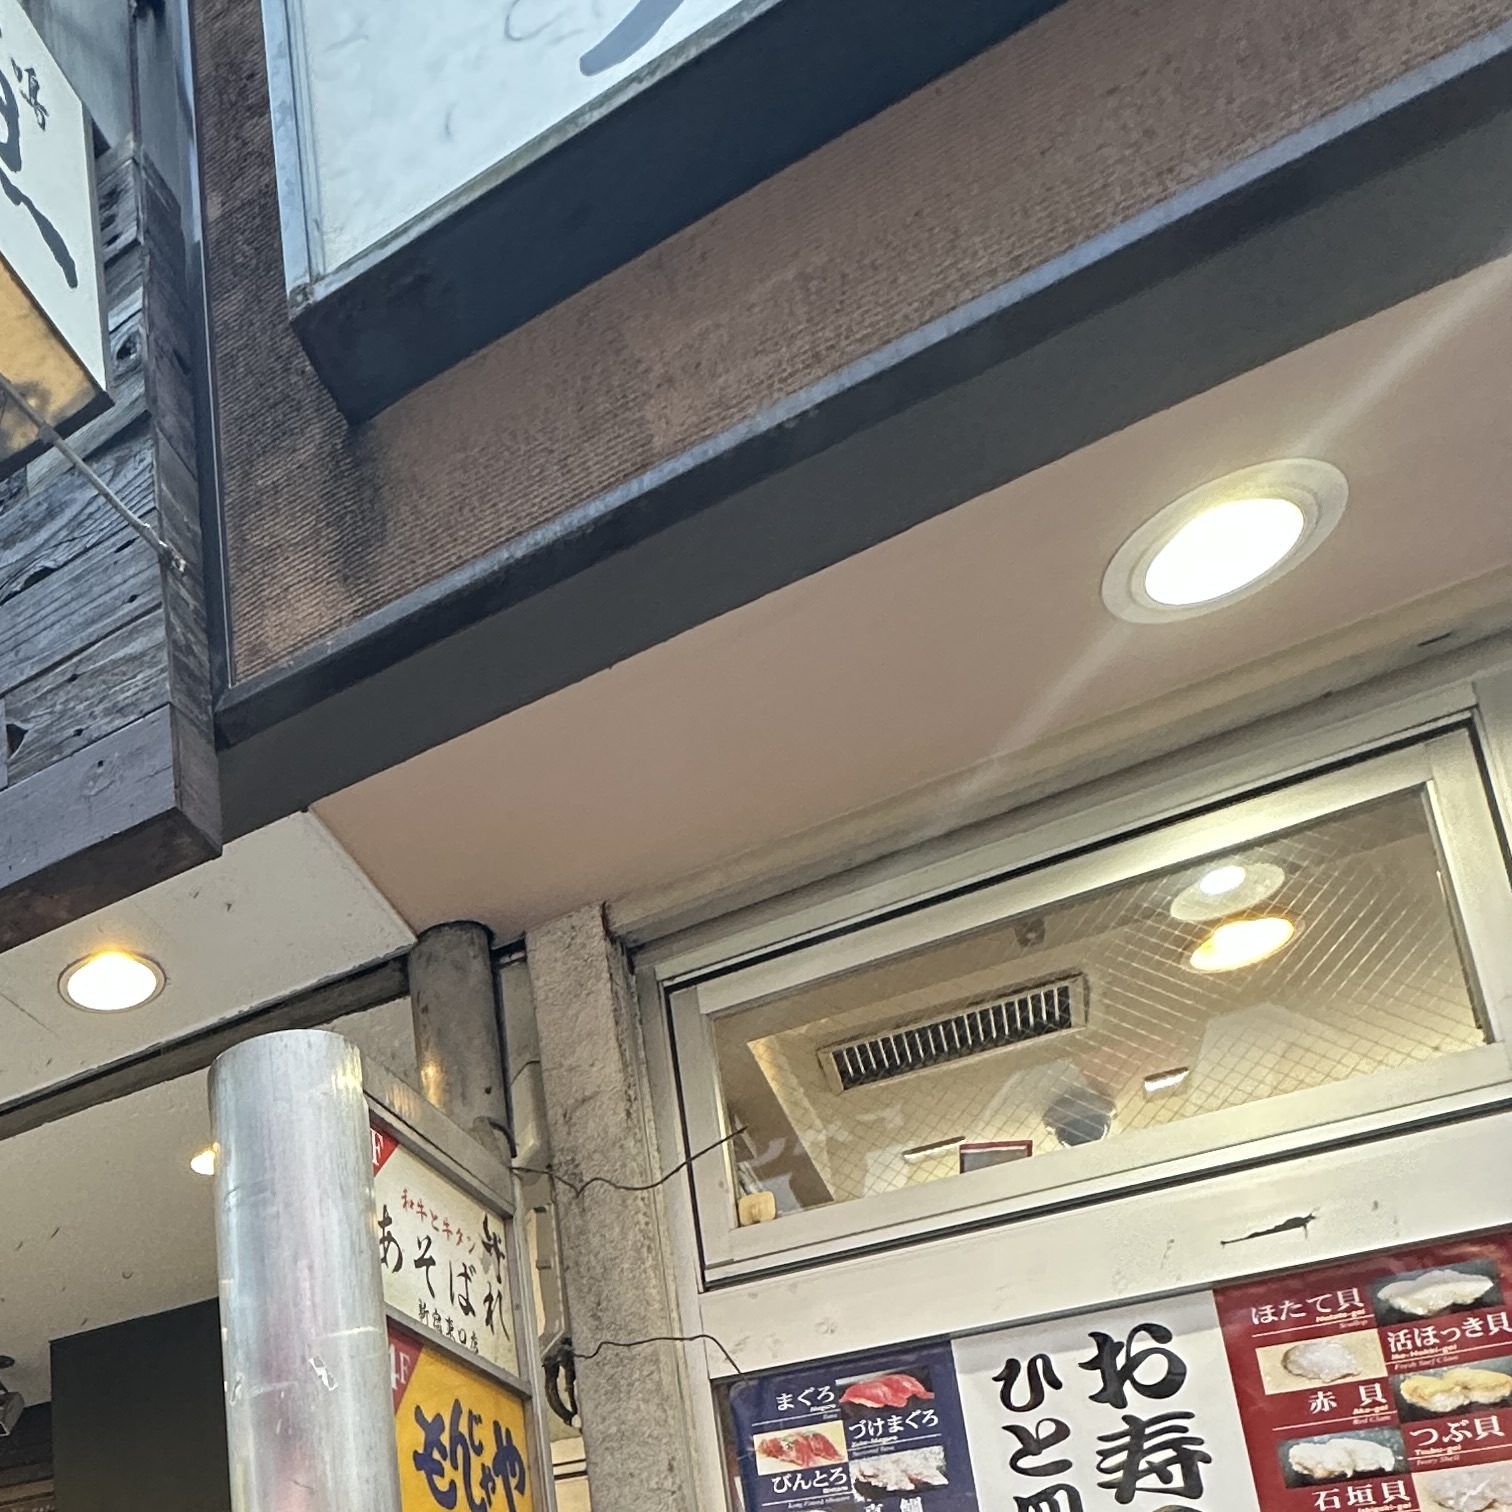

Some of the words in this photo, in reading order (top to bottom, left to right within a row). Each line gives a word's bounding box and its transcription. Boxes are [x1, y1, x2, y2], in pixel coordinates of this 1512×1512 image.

[1251, 1287, 1364, 1325] ほたて貝
[1388, 1311, 1512, 1353] 活ほっき貝
[775, 1385, 835, 1411] まぐろ
[1309, 1382, 1387, 1414] 赤貝
[849, 1409, 939, 1439] づけまぐろ
[1408, 1414, 1504, 1447] つぶ貝
[772, 1467, 847, 1494] びんとろ
[1312, 1479, 1410, 1512] 石垣貝
